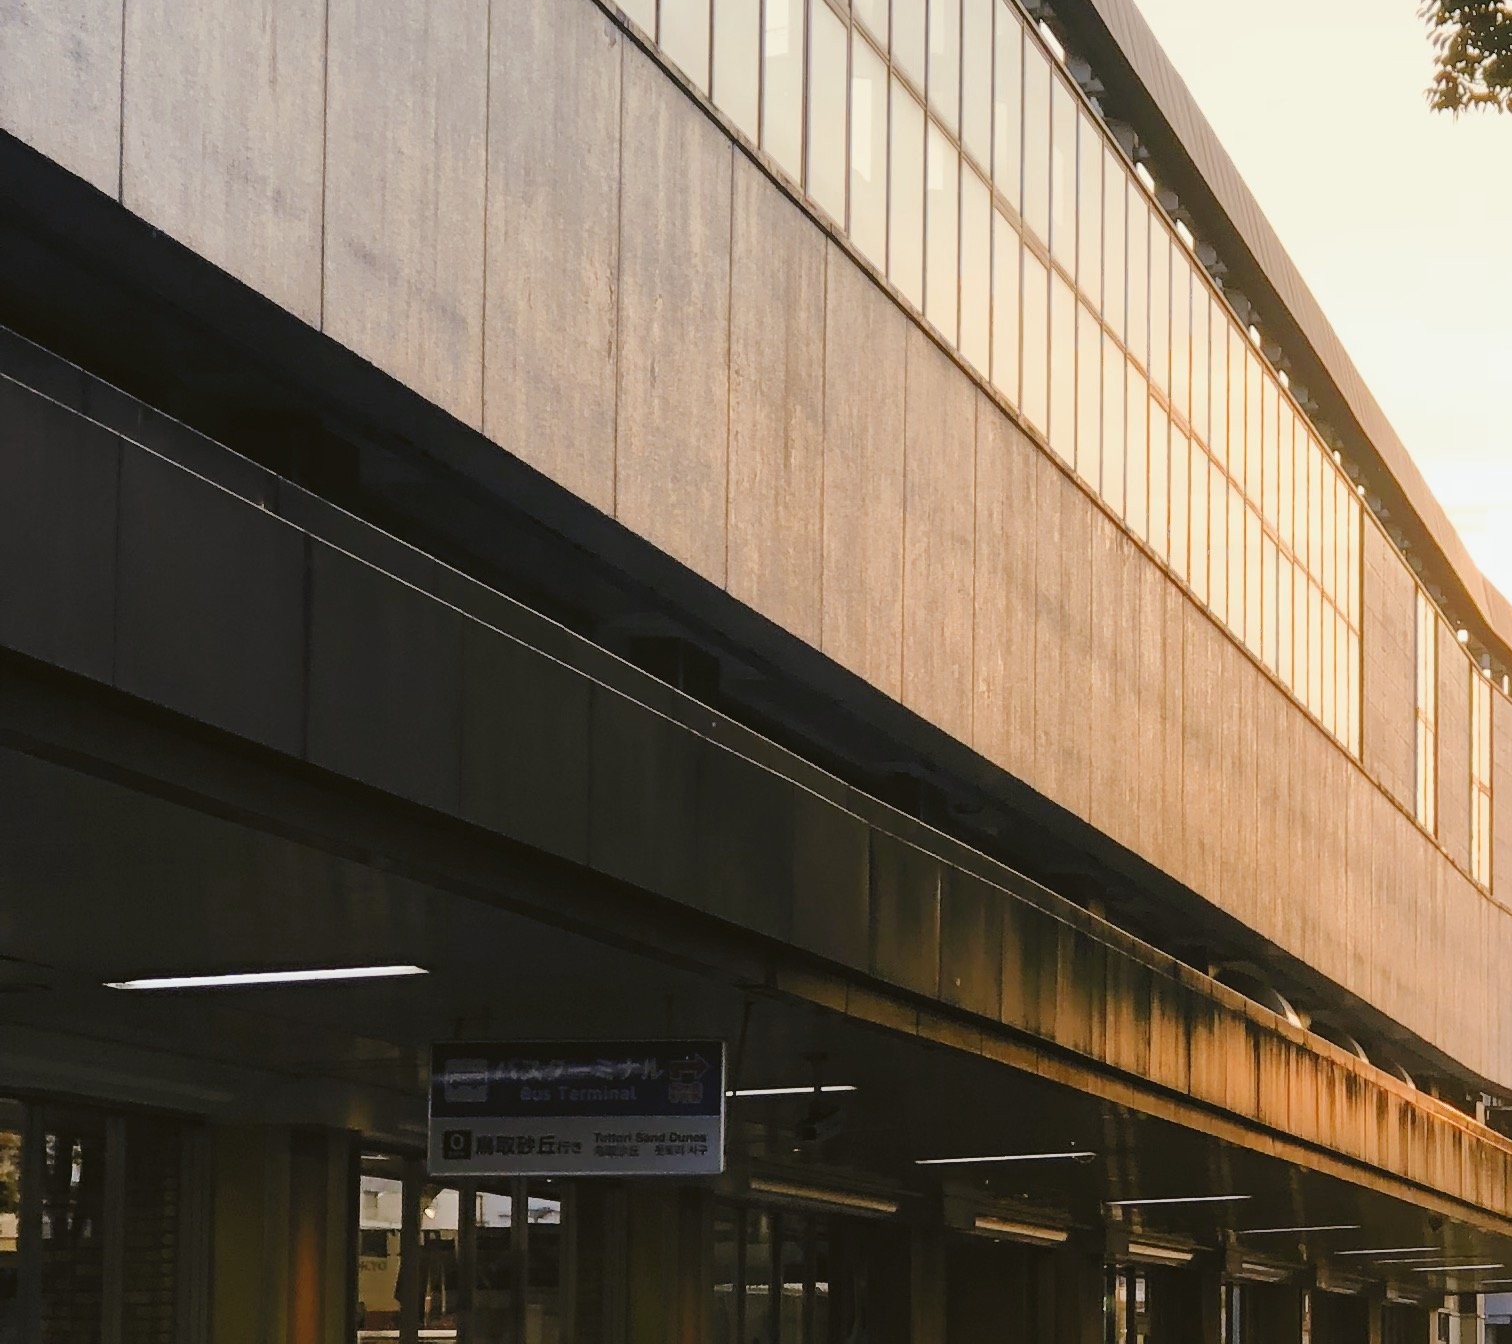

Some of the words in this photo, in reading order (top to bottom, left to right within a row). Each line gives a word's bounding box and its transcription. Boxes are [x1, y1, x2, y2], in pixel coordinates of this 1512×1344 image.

[490, 1056, 664, 1081] バスターミナル
[520, 1086, 552, 1102] Bus
[558, 1085, 638, 1102] Terminal
[636, 1132, 666, 1143] Sand
[669, 1132, 708, 1143] Dunes
